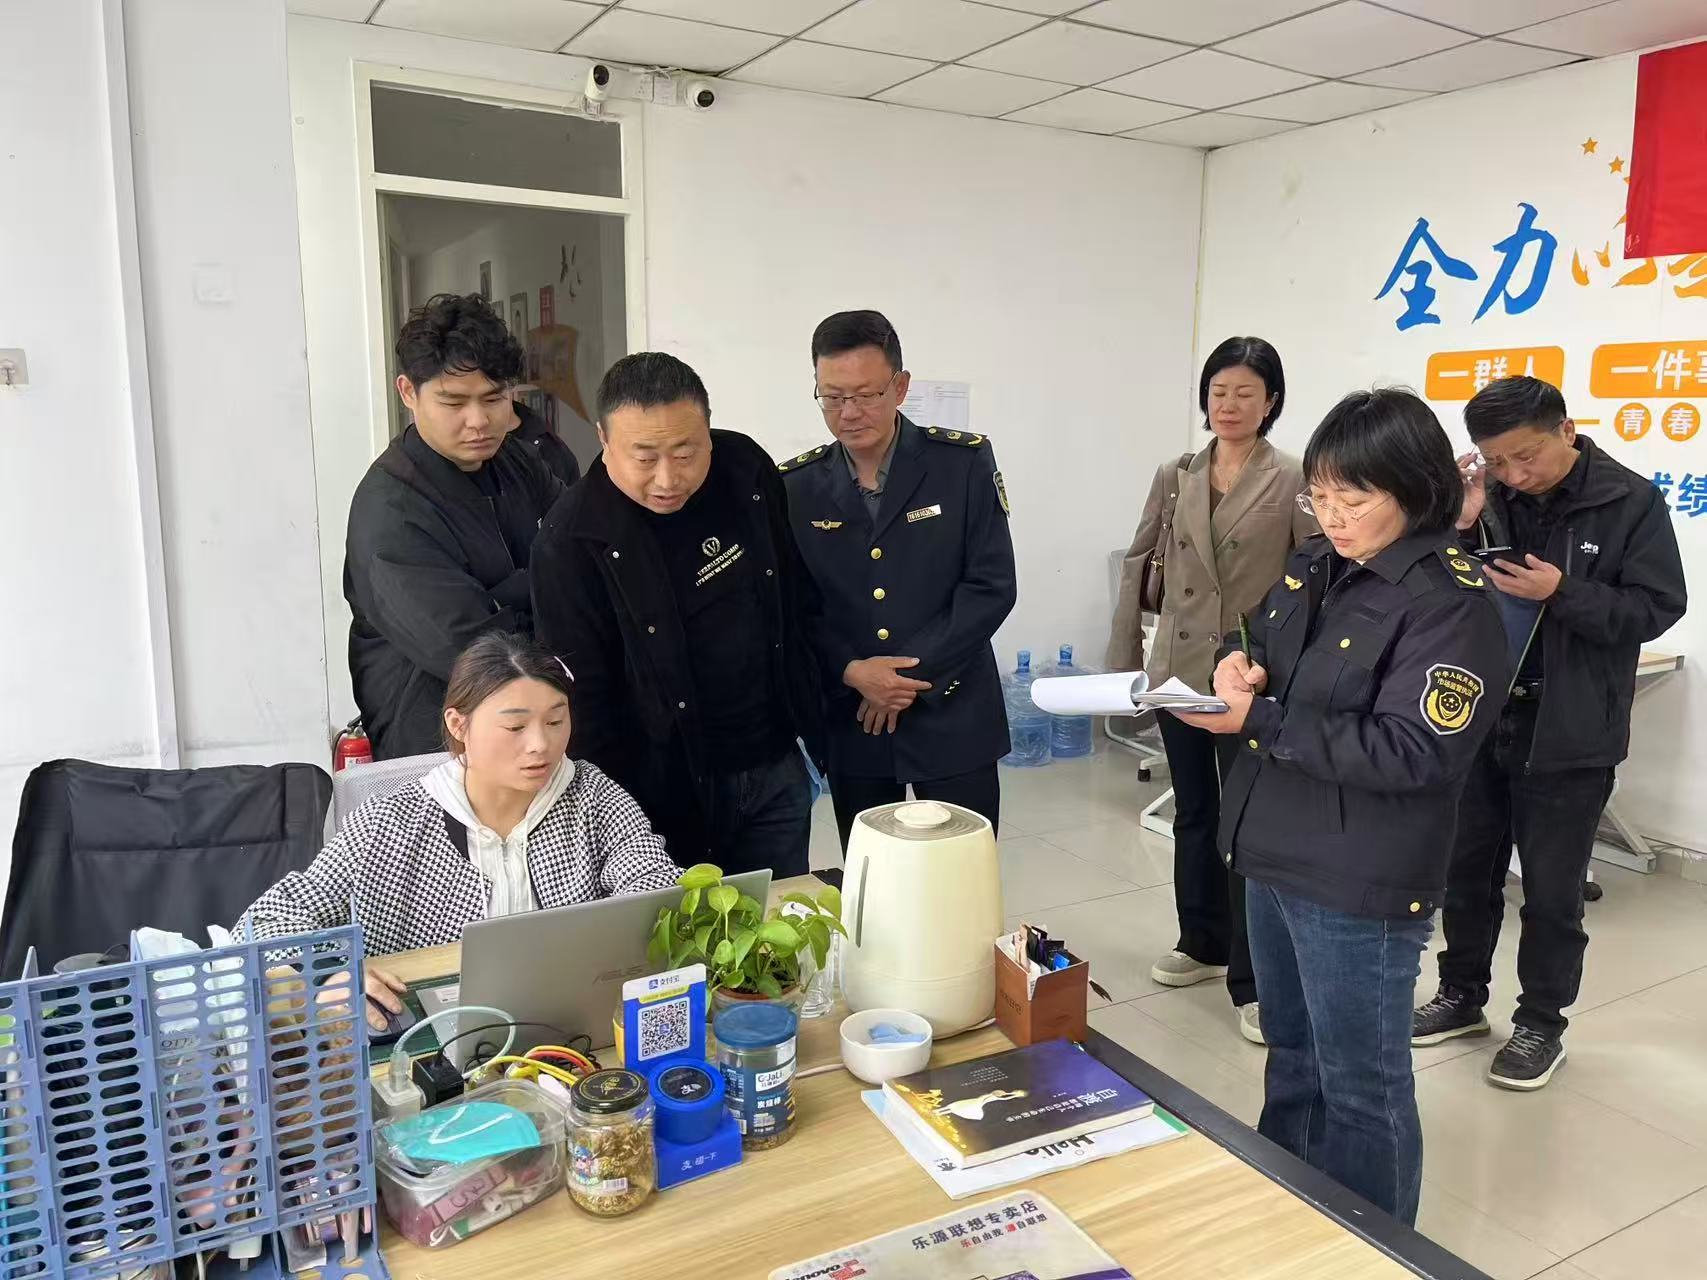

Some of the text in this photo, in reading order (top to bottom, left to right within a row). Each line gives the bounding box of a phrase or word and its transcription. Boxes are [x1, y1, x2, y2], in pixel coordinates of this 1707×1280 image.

[911, 1199, 1040, 1250] 乐源联想专卖店
[785, 1264, 841, 1280] novo
